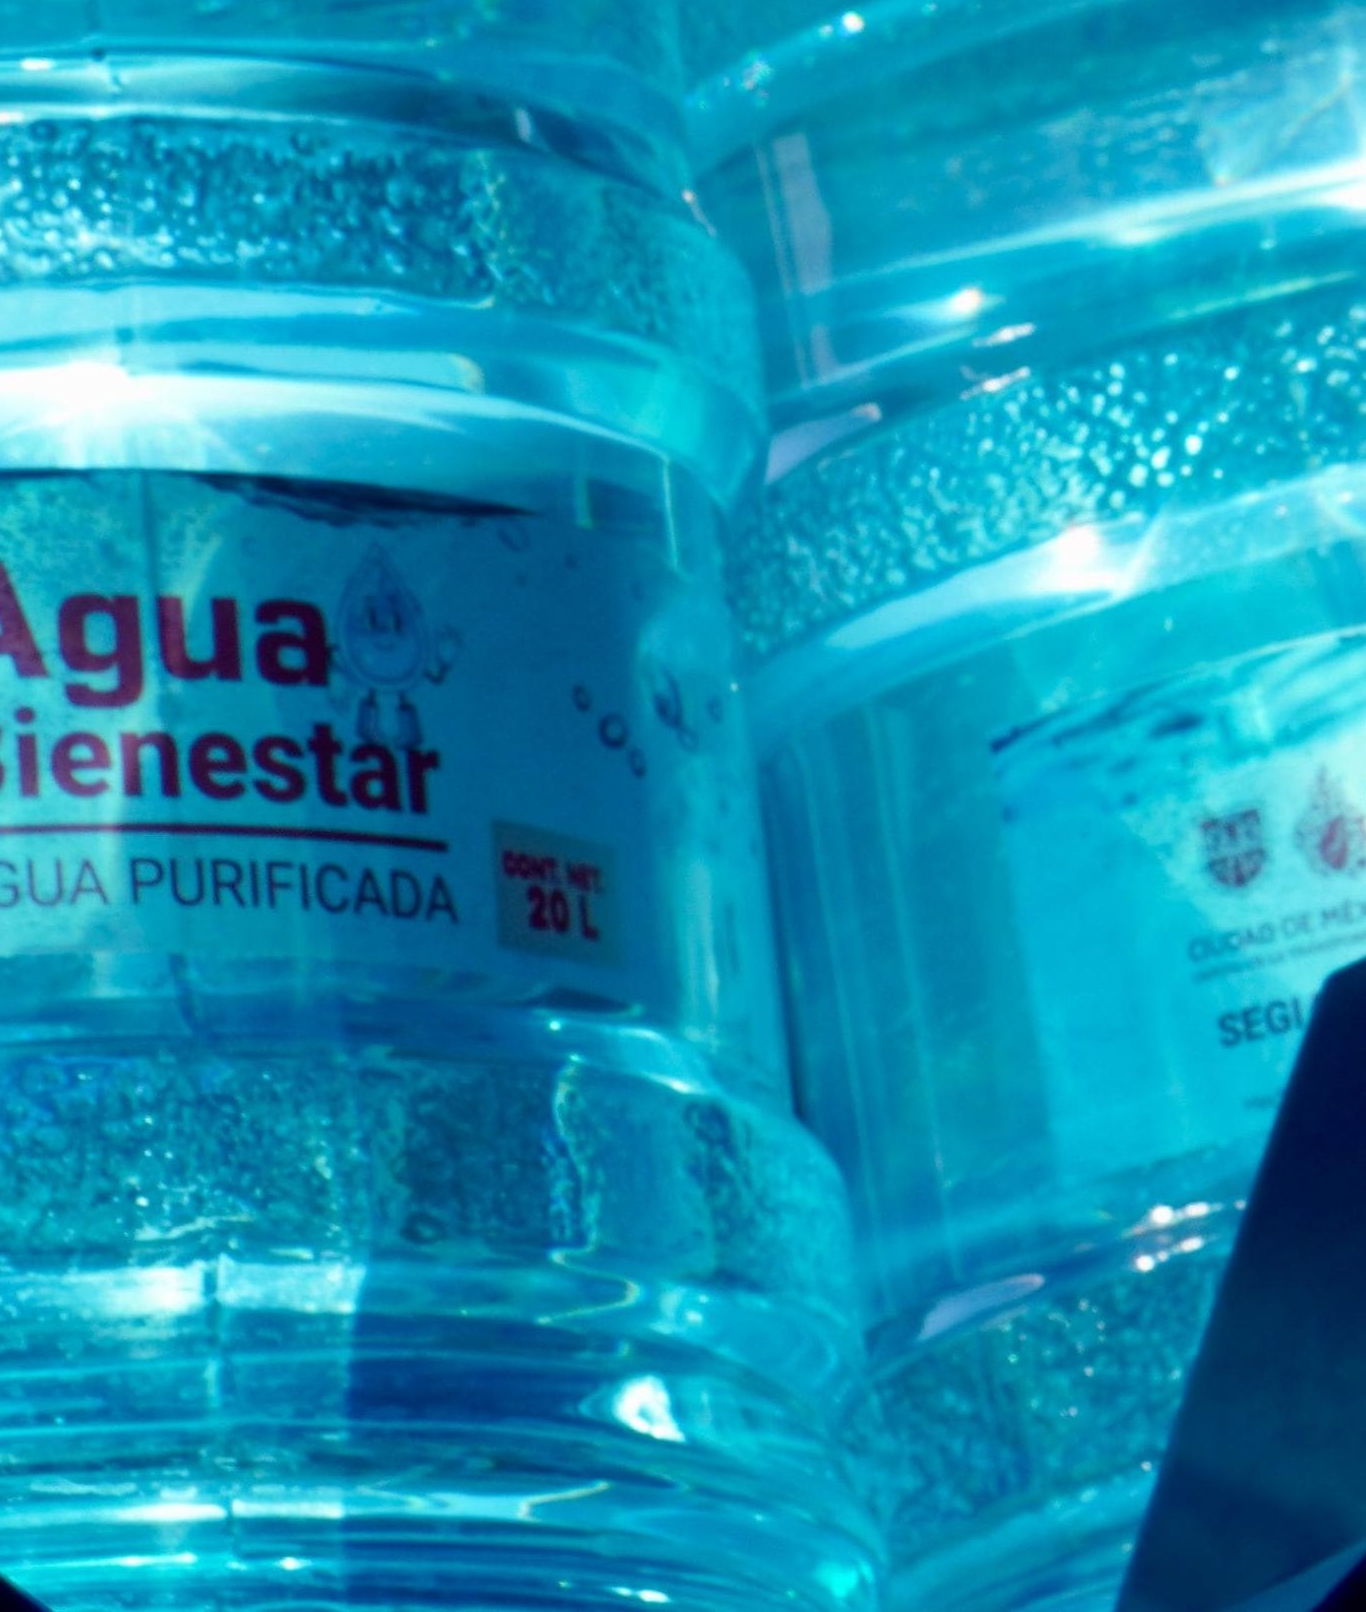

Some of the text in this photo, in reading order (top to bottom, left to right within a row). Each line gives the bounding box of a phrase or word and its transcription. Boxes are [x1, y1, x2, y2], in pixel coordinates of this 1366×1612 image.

[133, 856, 459, 925] PURIFICADA
[526, 885, 600, 943] 20 L
